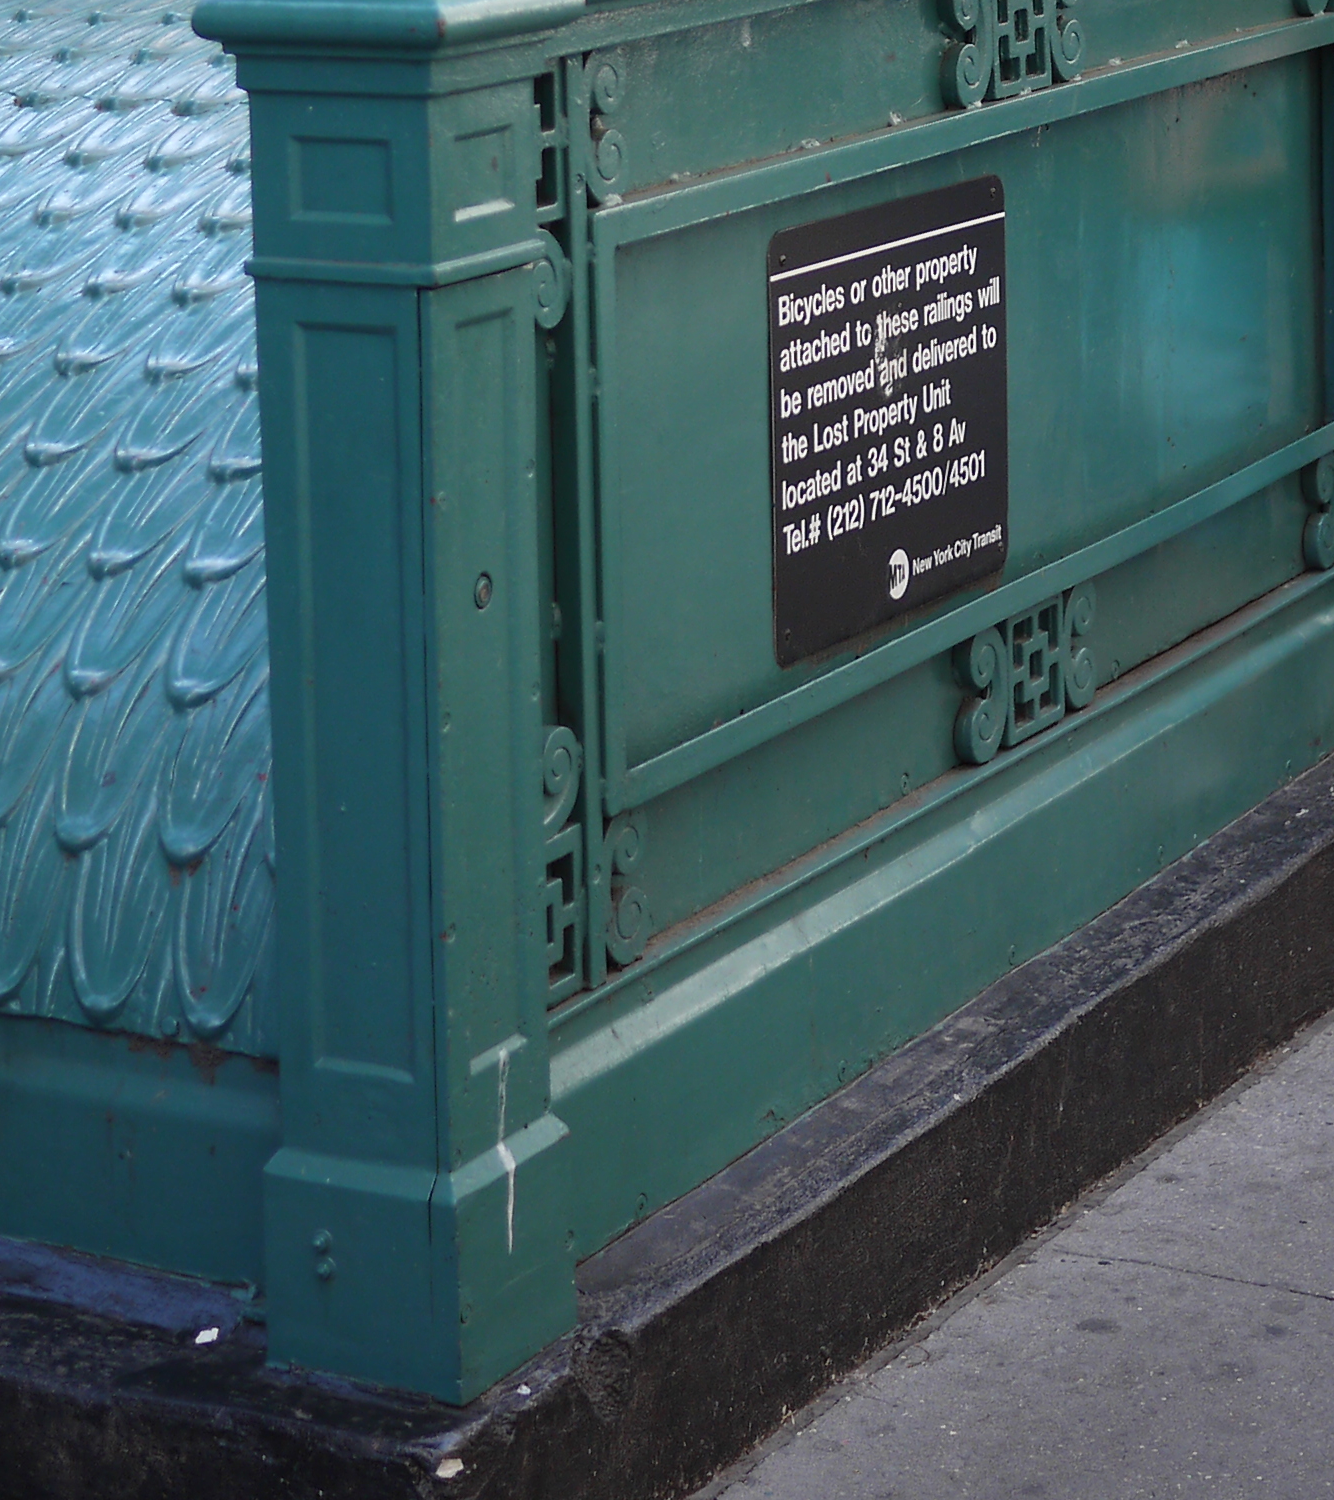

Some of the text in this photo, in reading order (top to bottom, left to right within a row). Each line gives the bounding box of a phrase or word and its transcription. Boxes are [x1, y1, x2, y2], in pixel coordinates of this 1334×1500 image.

[777, 243, 977, 327] Bicycles or other property
[780, 275, 1000, 372] attached to these railings will
[780, 322, 997, 419] be removed and delivered to
[782, 377, 951, 465] the Lost Property Unit
[782, 418, 967, 511] located at 34 St & 8 Av
[783, 448, 986, 556] Tel.# (212) 712-4500/4501
[912, 557, 933, 576] New
[933, 544, 954, 566] York
[954, 538, 972, 558] City
[972, 524, 1002, 550] Transit
